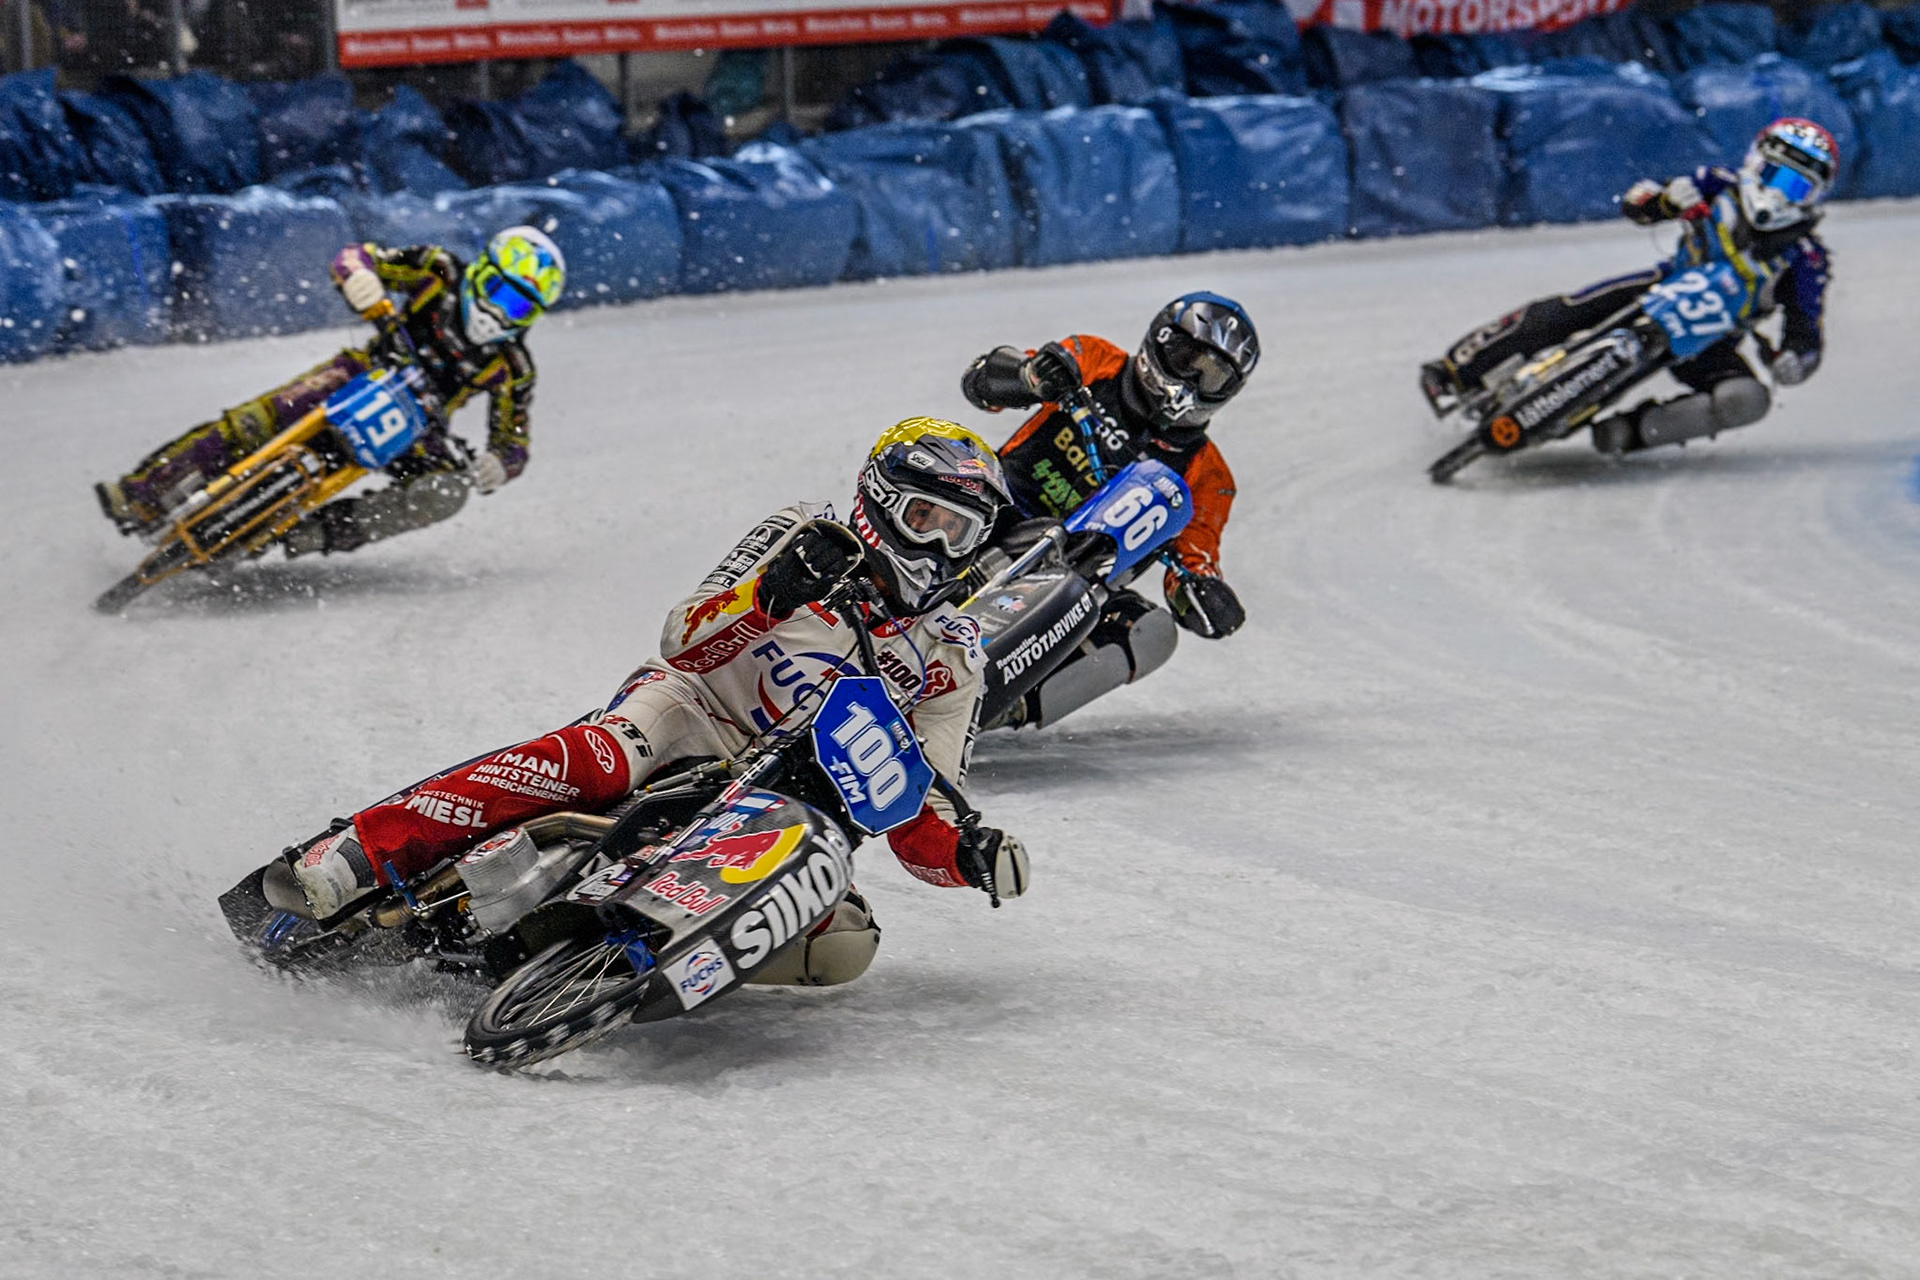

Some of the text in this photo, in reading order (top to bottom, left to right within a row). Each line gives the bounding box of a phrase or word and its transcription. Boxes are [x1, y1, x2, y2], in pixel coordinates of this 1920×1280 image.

[1379, 0, 1626, 35] MOTORSPO
[1656, 272, 1733, 335] 237
[355, 390, 408, 448] 19
[1095, 402, 1130, 450] 66
[1103, 487, 1168, 551] 66
[1003, 602, 1085, 685] AUTOTARVIKE
[752, 640, 826, 712] FUC
[877, 651, 922, 691] #100
[501, 753, 561, 778] MAN
[830, 701, 908, 812] 100
[419, 789, 485, 809] STECHNIK
[467, 773, 490, 784] BAD
[475, 764, 581, 797] HINTSTEINER
[830, 756, 867, 804] FIM
[404, 794, 488, 829] MIESL
[649, 872, 690, 900] Red
[679, 885, 727, 915] Bull
[680, 957, 724, 993] FUCHS
